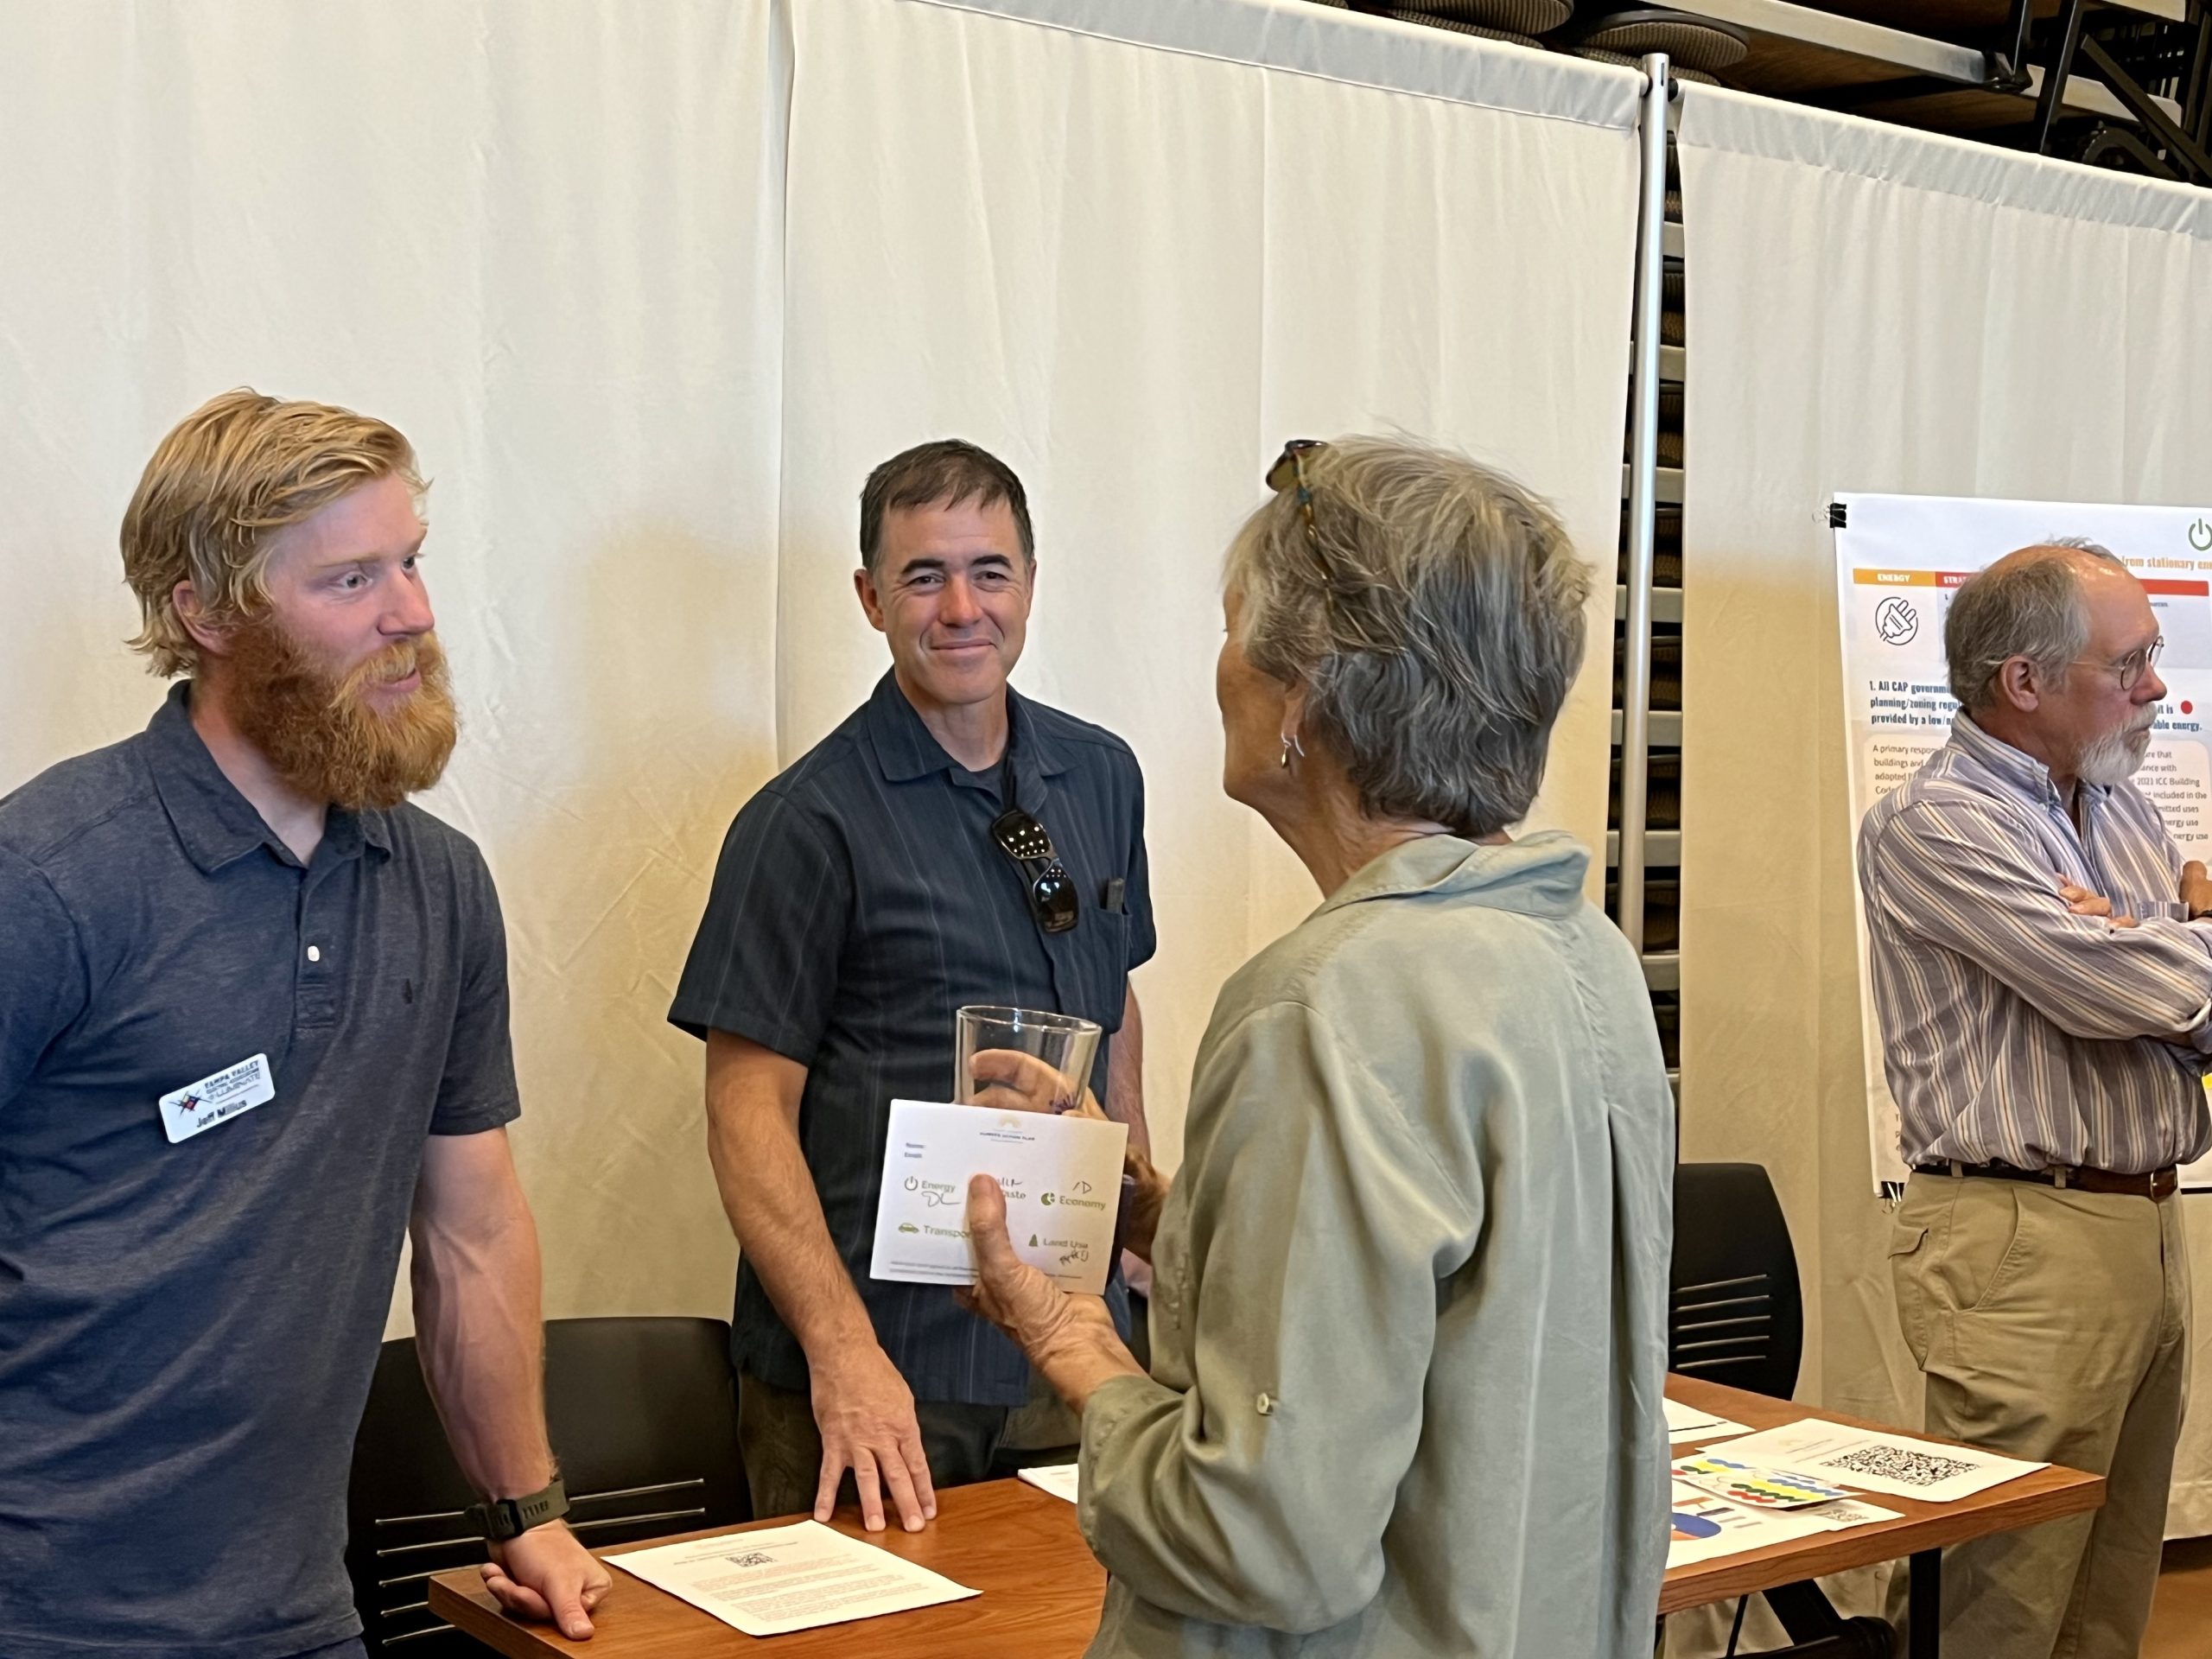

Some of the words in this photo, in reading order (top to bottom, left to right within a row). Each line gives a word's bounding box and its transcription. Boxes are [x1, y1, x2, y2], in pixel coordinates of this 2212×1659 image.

[2147, 556, 2195, 570] stationary
[1877, 573, 1911, 582] ENERGY
[1869, 681, 1876, 690] 1.
[1878, 681, 1890, 691] All
[1891, 682, 1909, 692] CAP
[1911, 685, 1951, 695] governm
[1939, 701, 1961, 711] regul
[2166, 704, 2173, 715] is
[1872, 714, 1907, 725] provided
[1909, 714, 1918, 726] by
[1929, 715, 1952, 726] low/n
[2152, 720, 2170, 730] able
[2172, 722, 2202, 733] energy.
[1880, 745, 1909, 754] primary
[1873, 758, 1908, 769] buildings
[2170, 778, 2200, 787] Building
[2153, 791, 2185, 799] included
[921, 1180, 956, 1193] Energy
[1004, 1189, 1027, 1199] aste
[1059, 1195, 1106, 1211] Economy
[1043, 1237, 1068, 1248] Land
[1070, 1240, 1089, 1249] Use
